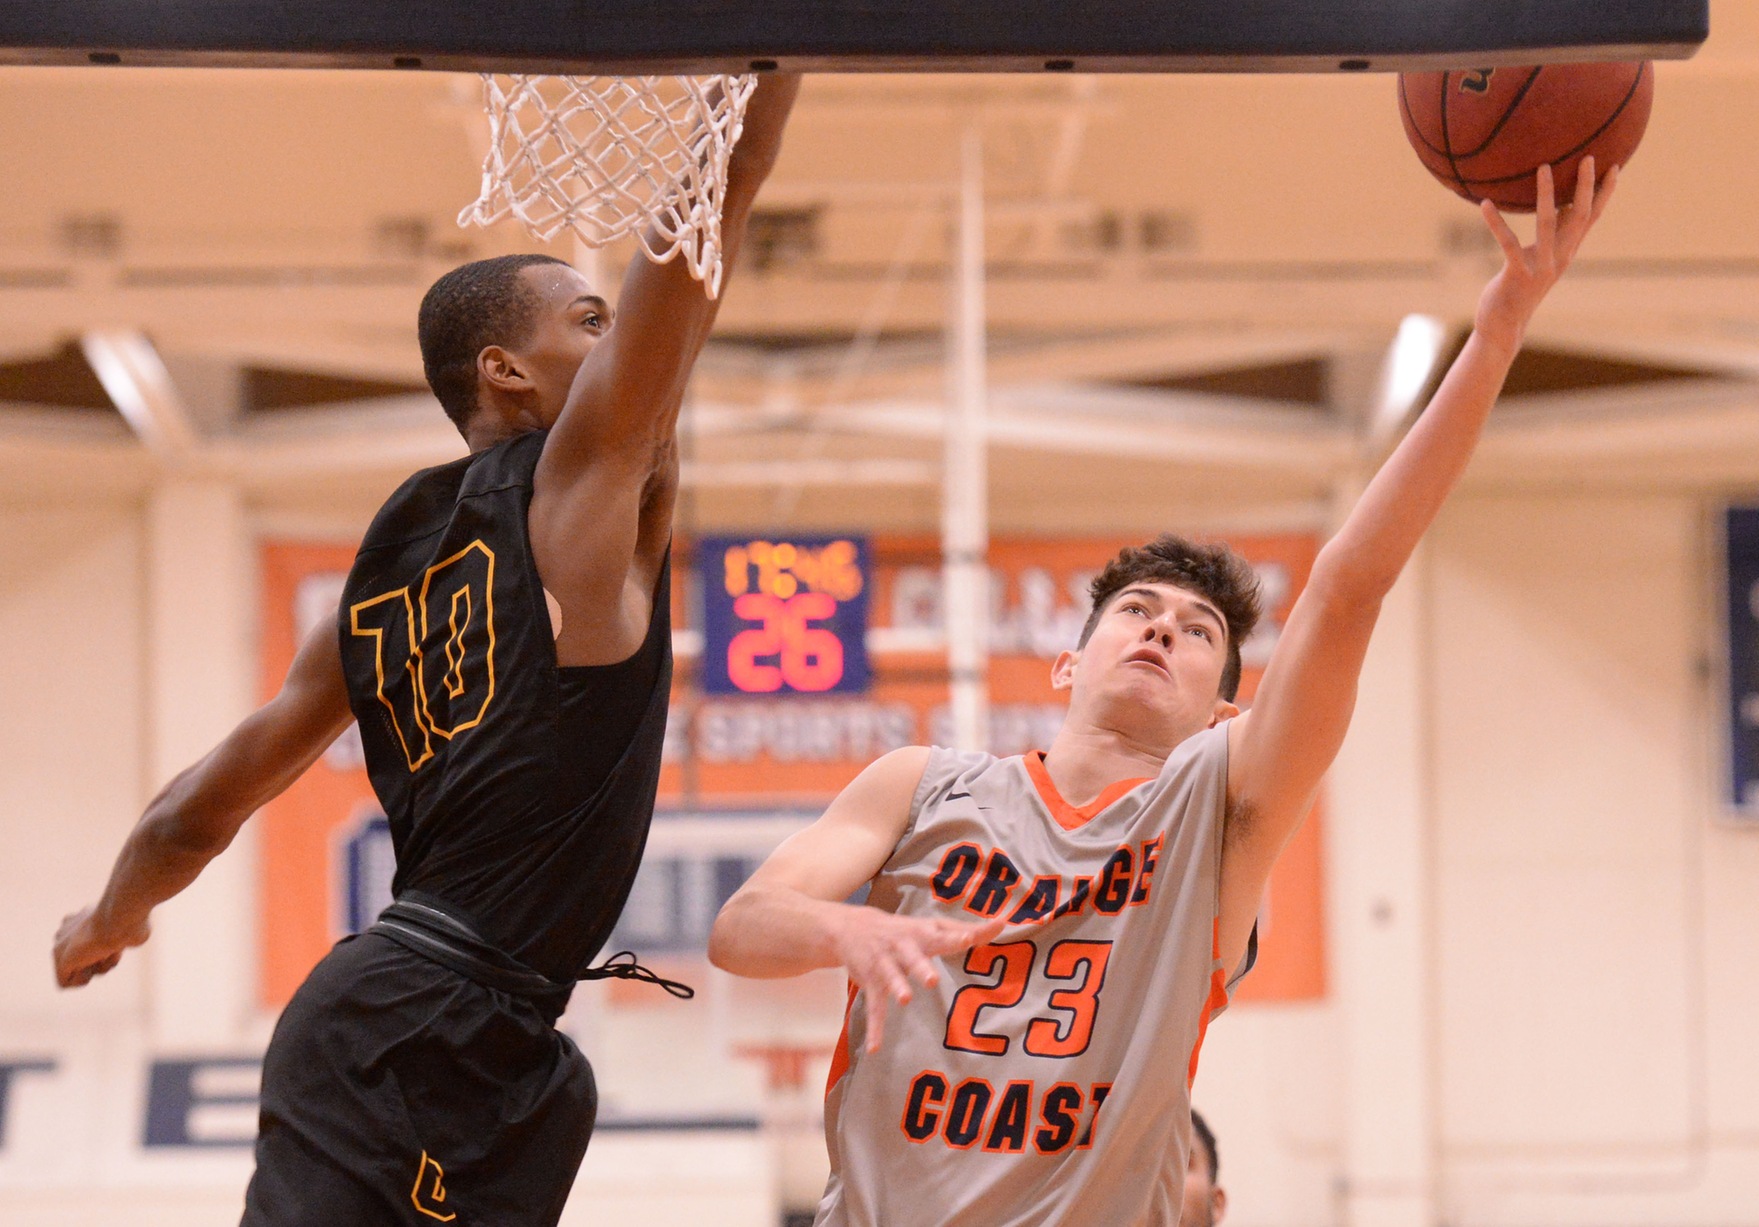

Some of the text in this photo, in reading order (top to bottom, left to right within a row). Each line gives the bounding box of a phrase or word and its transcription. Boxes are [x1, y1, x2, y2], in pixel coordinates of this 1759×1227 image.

[350, 539, 495, 773] 10
[727, 592, 844, 693] 26
[943, 939, 1114, 1059] 23
